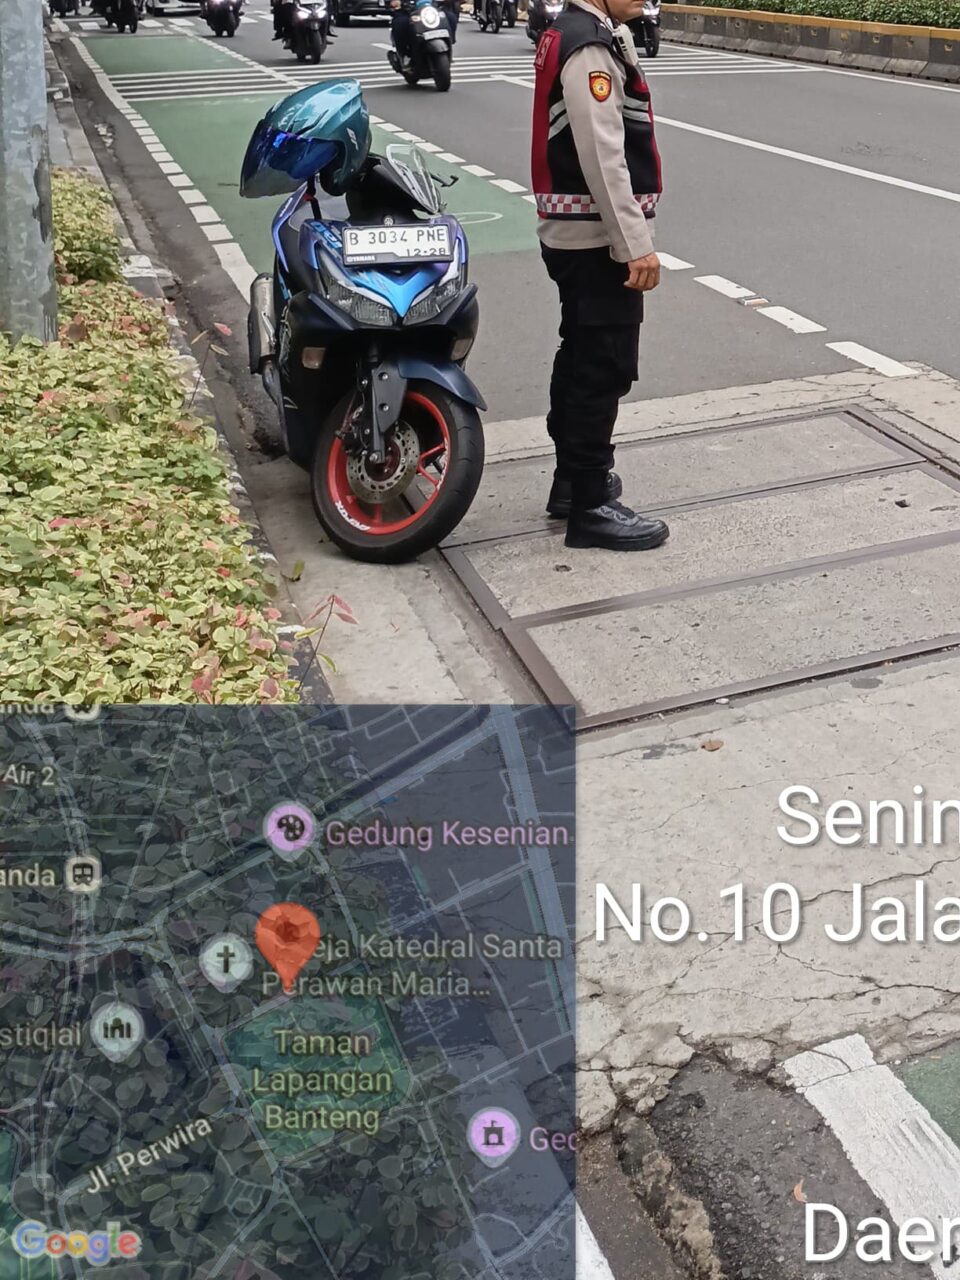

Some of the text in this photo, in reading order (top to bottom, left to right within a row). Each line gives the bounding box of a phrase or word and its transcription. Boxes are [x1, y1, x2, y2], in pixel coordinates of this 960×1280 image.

[349, 232, 359, 246] B
[368, 230, 408, 245] 3034
[416, 228, 446, 242] PNE
